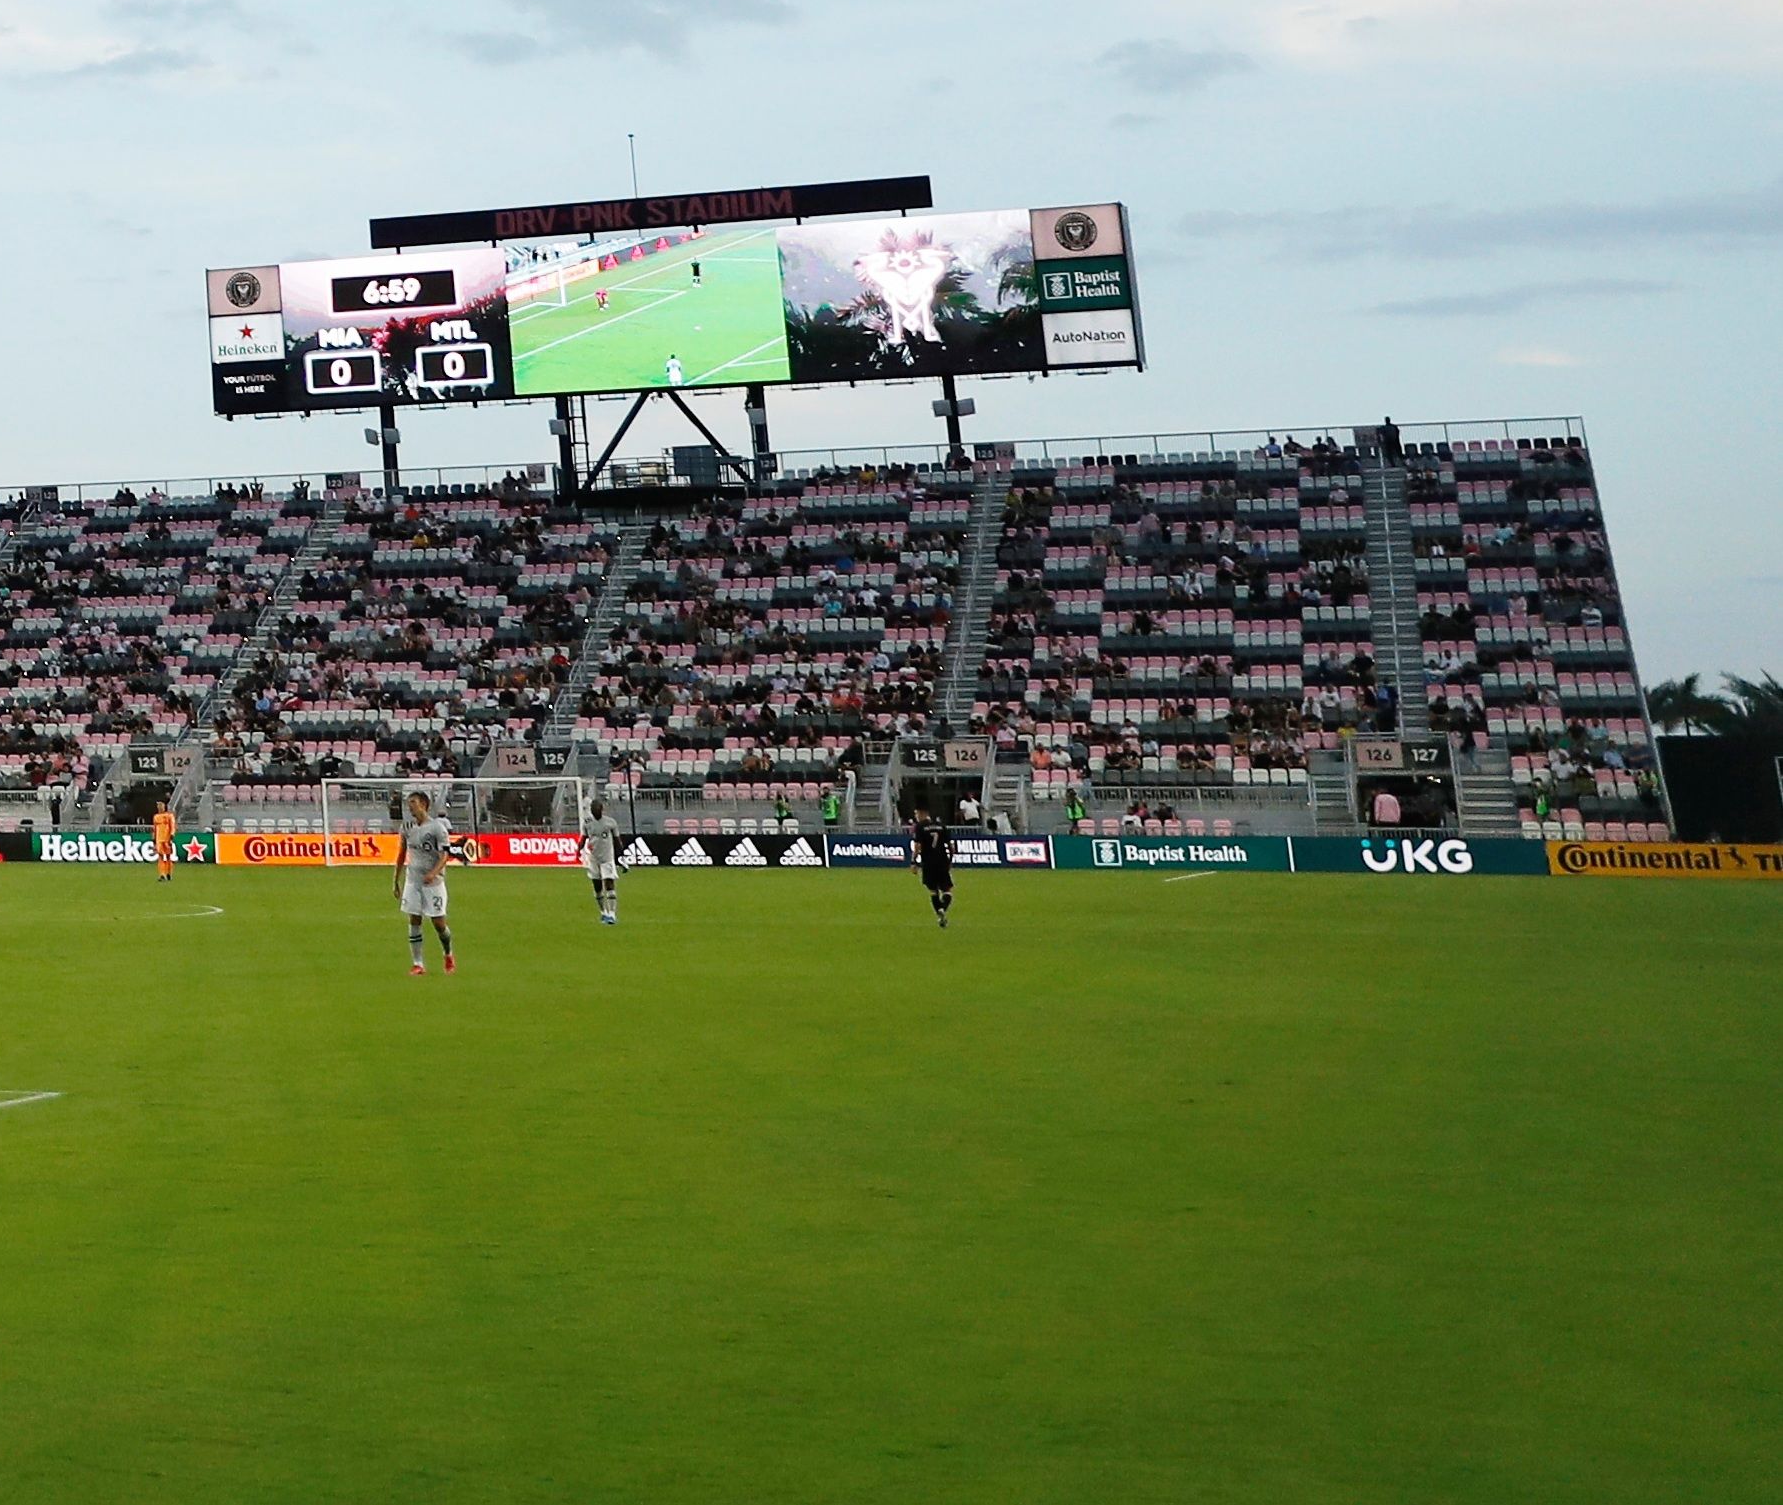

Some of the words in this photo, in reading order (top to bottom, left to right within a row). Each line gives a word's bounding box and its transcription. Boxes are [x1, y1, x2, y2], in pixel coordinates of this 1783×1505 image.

[495, 208, 556, 236] DRV
[573, 203, 634, 231] PNK
[647, 189, 794, 225] STADIUM
[1074, 270, 1121, 286] Baptist
[363, 277, 422, 304] 6:59
[1076, 284, 1121, 298] Health
[430, 319, 478, 341] MTL
[1052, 330, 1126, 343] AutoNation
[318, 327, 364, 348] MIA
[217, 342, 278, 356] Heineken
[443, 351, 465, 378] 0
[330, 359, 352, 385] 0
[223, 375, 246, 384] YOUR
[235, 385, 245, 394] IS
[245, 384, 265, 394] HERE
[136, 756, 159, 768] 123
[505, 753, 528, 765] 124
[542, 752, 566, 765] 125
[912, 748, 938, 762] 125
[954, 749, 979, 762] 126
[1365, 749, 1393, 762] 126
[1411, 748, 1439, 762] 127
[244, 837, 361, 862] Continental
[832, 844, 905, 858] AutoNation
[957, 840, 998, 853] MILLION
[671, 854, 713, 866] adidas
[725, 854, 768, 866] adidas
[779, 854, 823, 867] adidas
[1125, 844, 1188, 865] Baptist
[1190, 845, 1247, 862] Health
[1361, 839, 1474, 873] UKG
[1557, 843, 1722, 873] Continental
